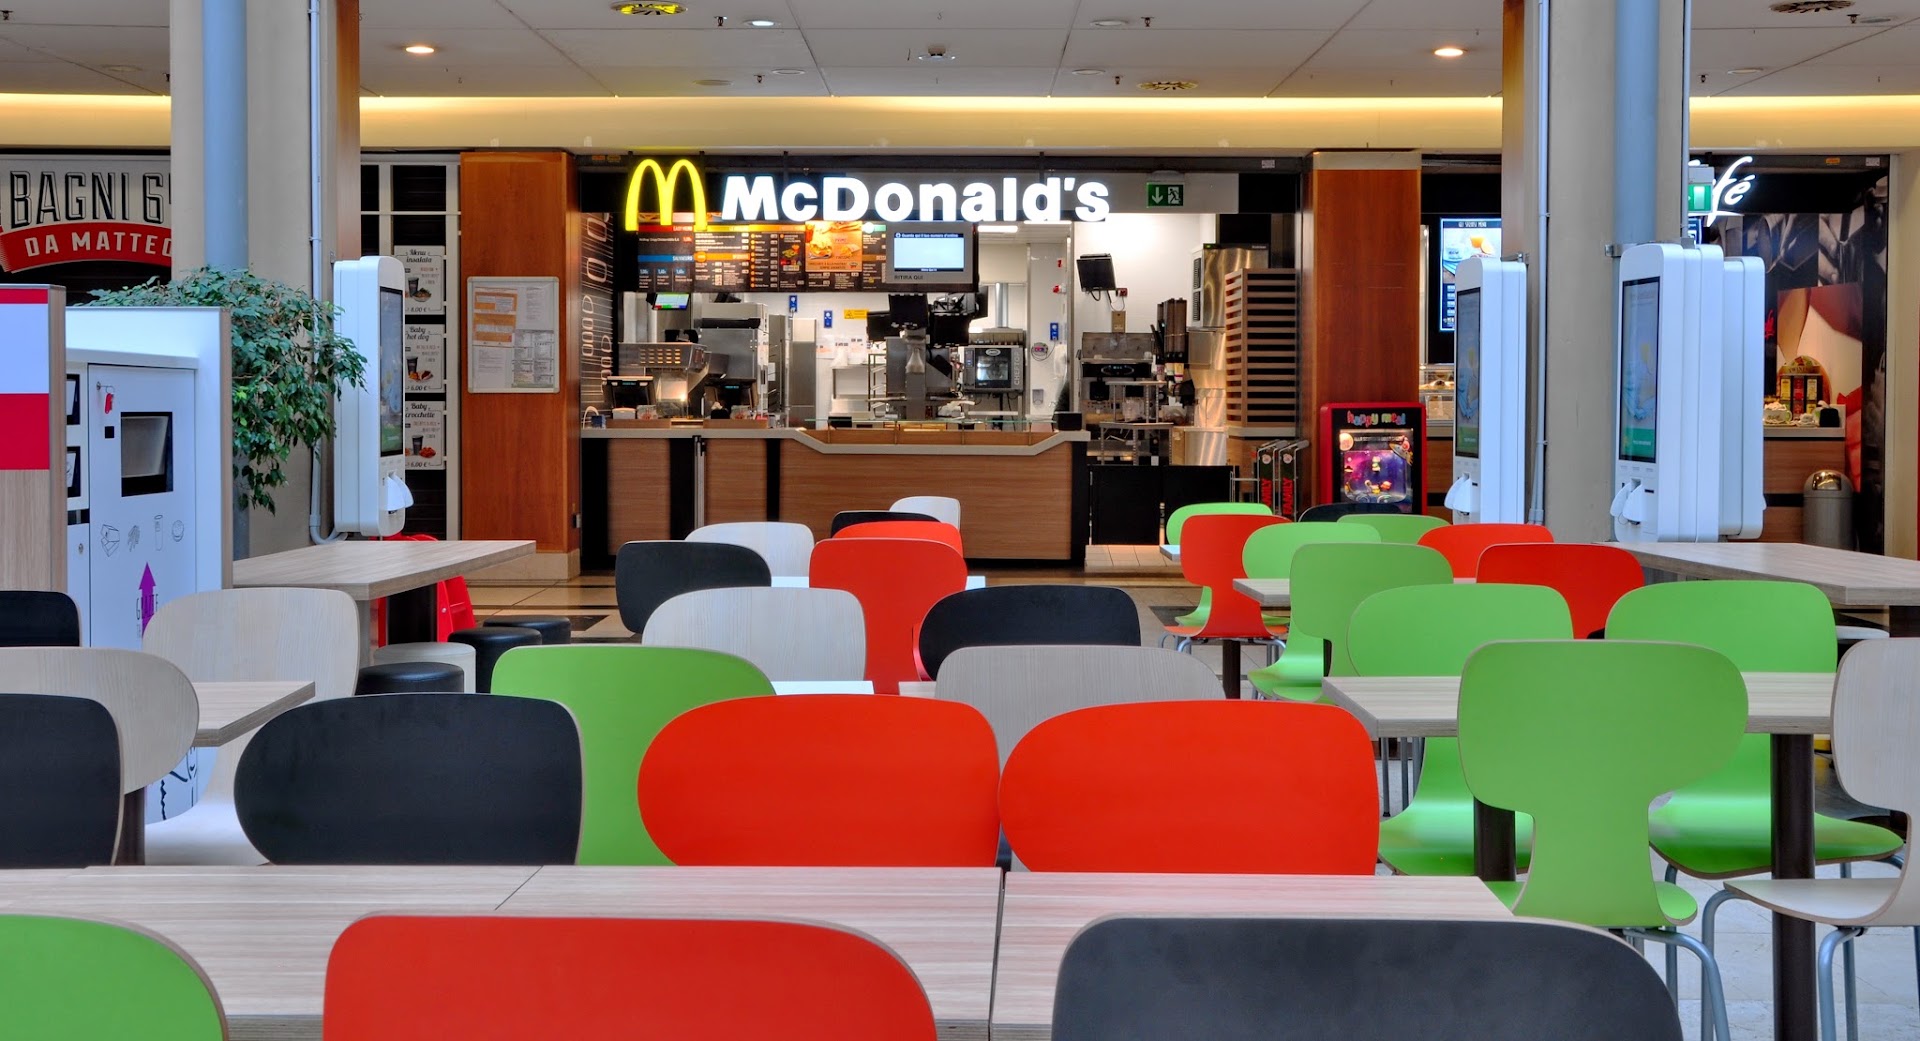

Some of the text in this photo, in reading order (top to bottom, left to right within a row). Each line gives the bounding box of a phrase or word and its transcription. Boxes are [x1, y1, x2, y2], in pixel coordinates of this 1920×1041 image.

[10, 171, 130, 229] BAGNI
[721, 176, 1110, 222] McDonald's
[24, 234, 59, 257] DA
[411, 402, 428, 411] Baby
[1347, 410, 1407, 428] happy meal
[1282, 477, 1294, 514] FAMILY
